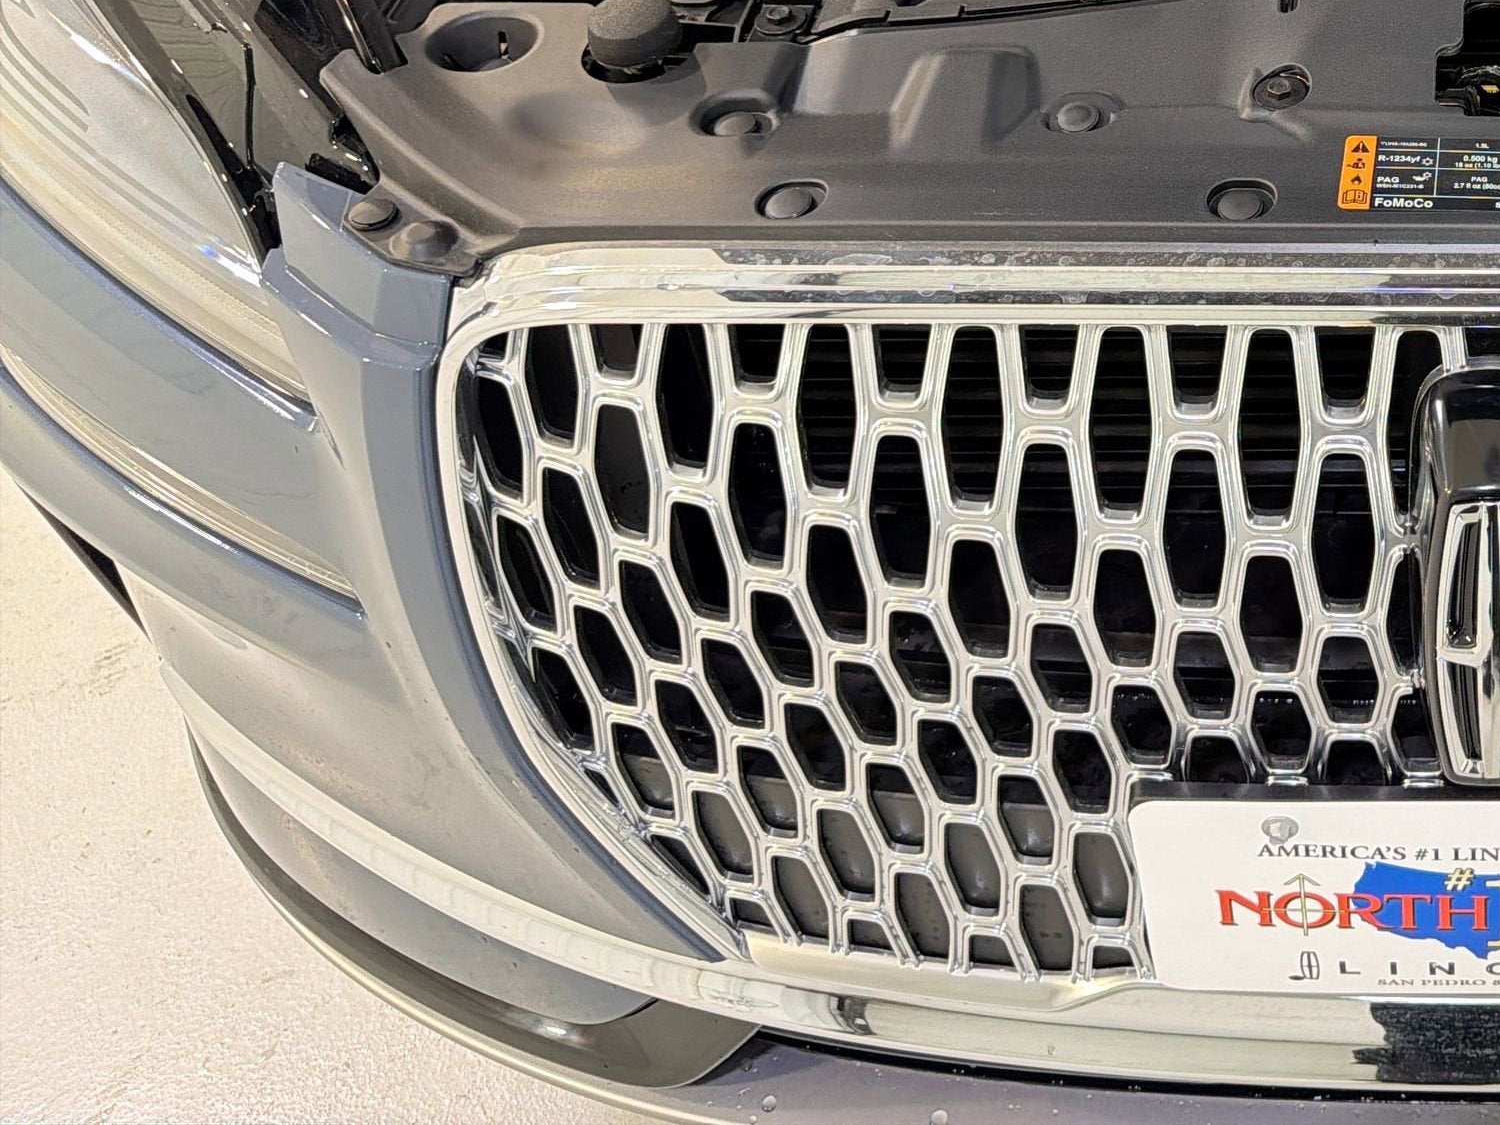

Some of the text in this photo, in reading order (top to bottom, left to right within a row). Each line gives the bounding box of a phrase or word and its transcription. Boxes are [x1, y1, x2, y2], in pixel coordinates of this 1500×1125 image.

[1378, 155, 1420, 163] R-1234yf
[1487, 156, 1498, 164] kg
[1374, 197, 1433, 208] FoMoCo
[1257, 843, 1407, 860] AMERICA'S
[1414, 847, 1443, 861] #1
[1215, 889, 1489, 931] NORTH
[1421, 979, 1487, 987] PEDRO
